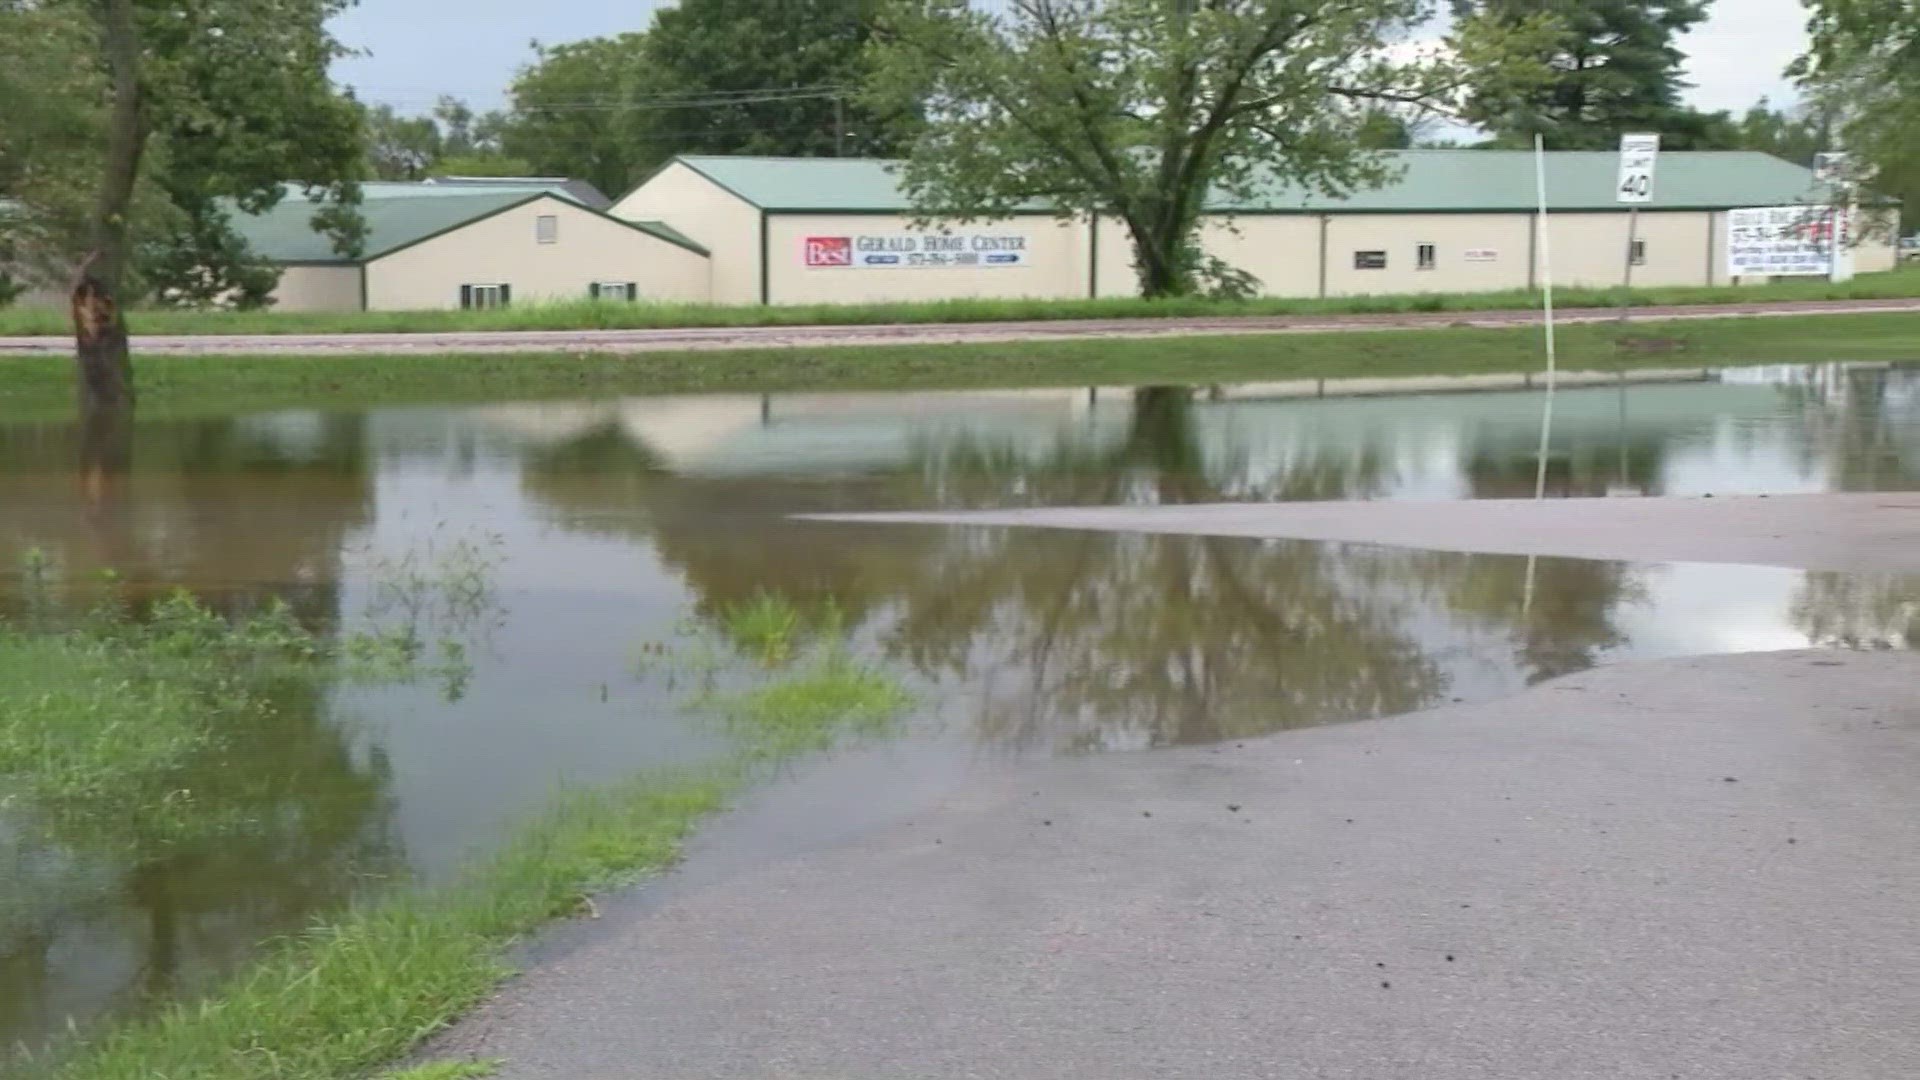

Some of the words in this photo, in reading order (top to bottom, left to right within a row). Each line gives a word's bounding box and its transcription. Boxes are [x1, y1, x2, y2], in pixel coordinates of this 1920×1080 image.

[1620, 174, 1651, 197] 40
[808, 242, 850, 265] Best
[857, 235, 917, 252] GERALD
[923, 236, 964, 252] HOME
[971, 235, 1026, 251] CENTER
